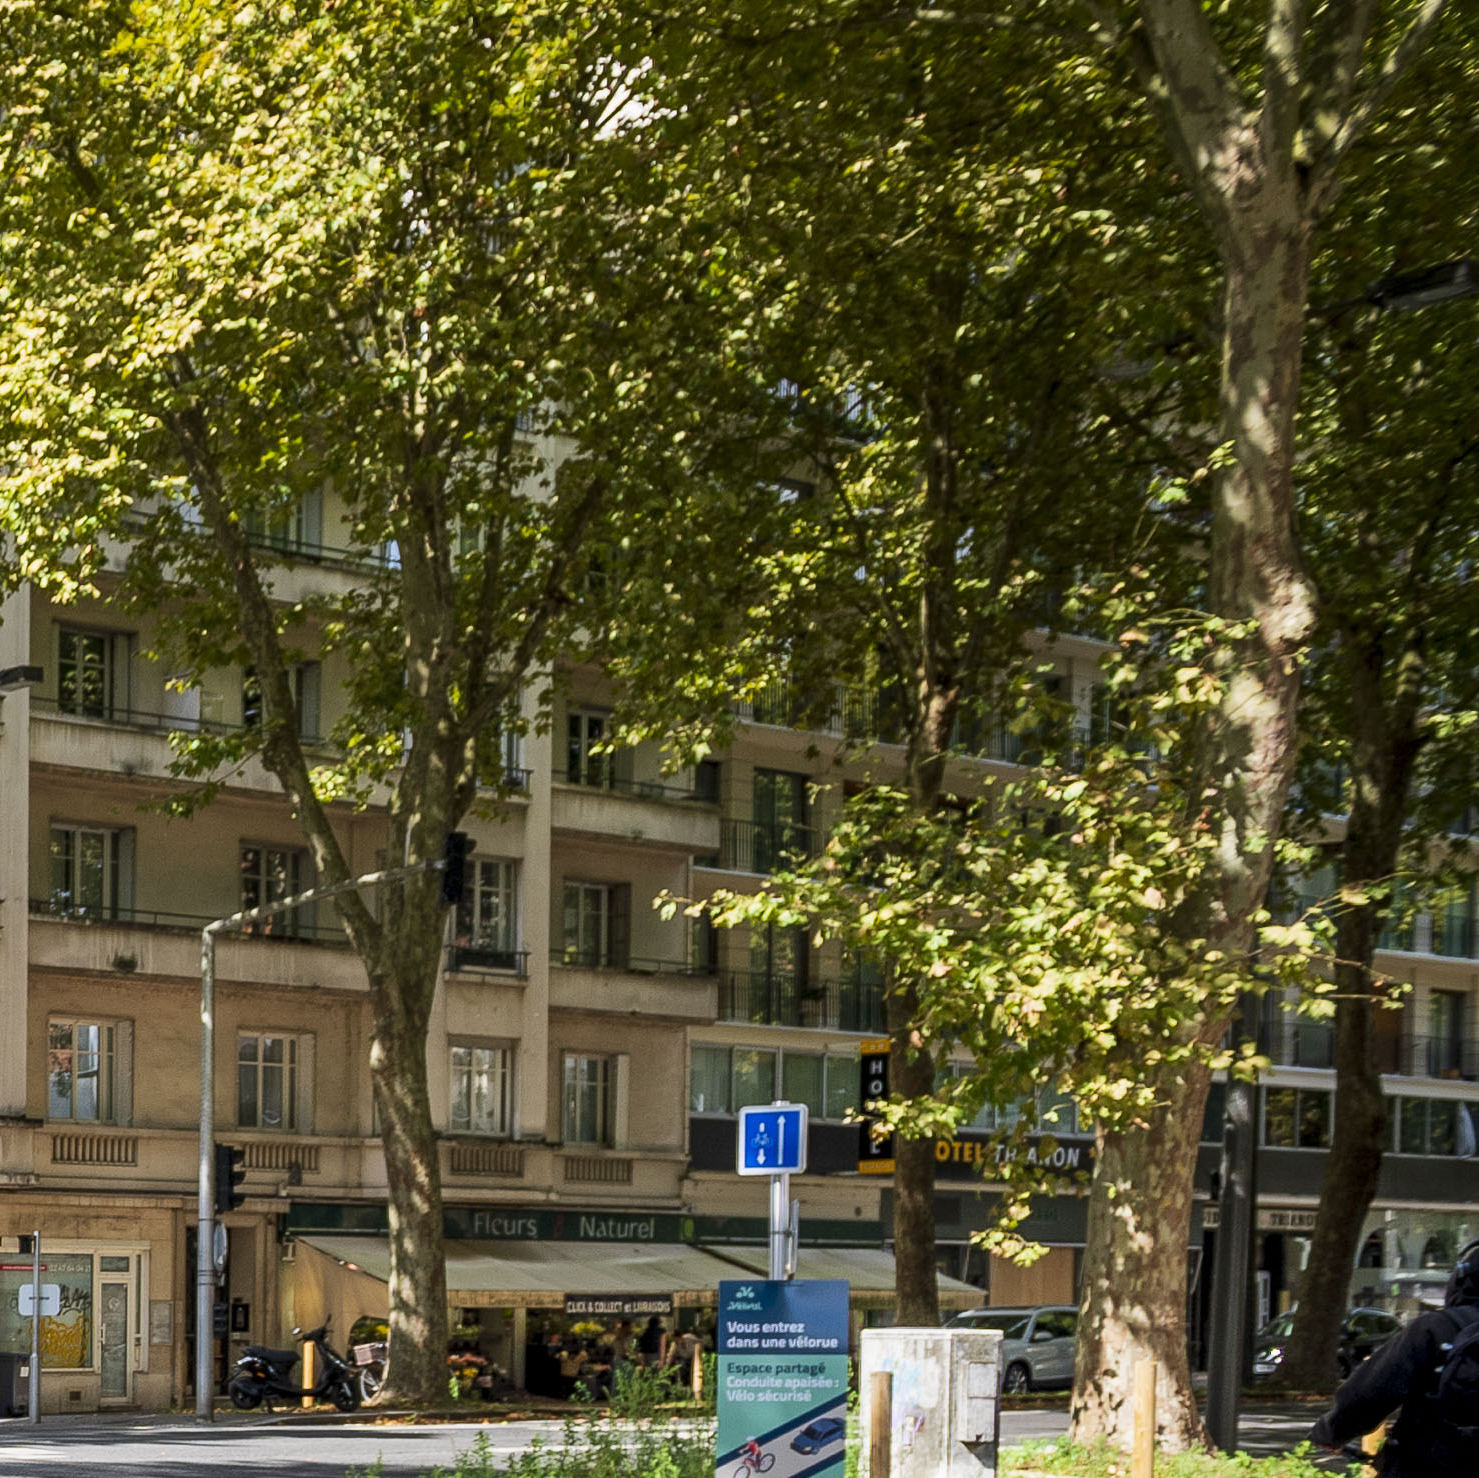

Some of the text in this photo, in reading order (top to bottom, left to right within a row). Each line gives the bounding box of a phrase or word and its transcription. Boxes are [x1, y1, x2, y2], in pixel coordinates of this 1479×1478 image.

[935, 1140, 984, 1163] OTEL
[474, 1212, 538, 1237] Fleurs
[579, 1215, 655, 1239] Naturel
[566, 1301, 587, 1313] CLICK
[594, 1301, 623, 1313] COLLECT
[726, 1321, 806, 1333] Vous entrez
[726, 1336, 839, 1348] dans une vélorue
[727, 1362, 826, 1377] Espace partagé
[726, 1376, 784, 1388] Conduite
[784, 1376, 833, 1390] apaisée
[726, 1390, 813, 1402] Vélo sécurisé
